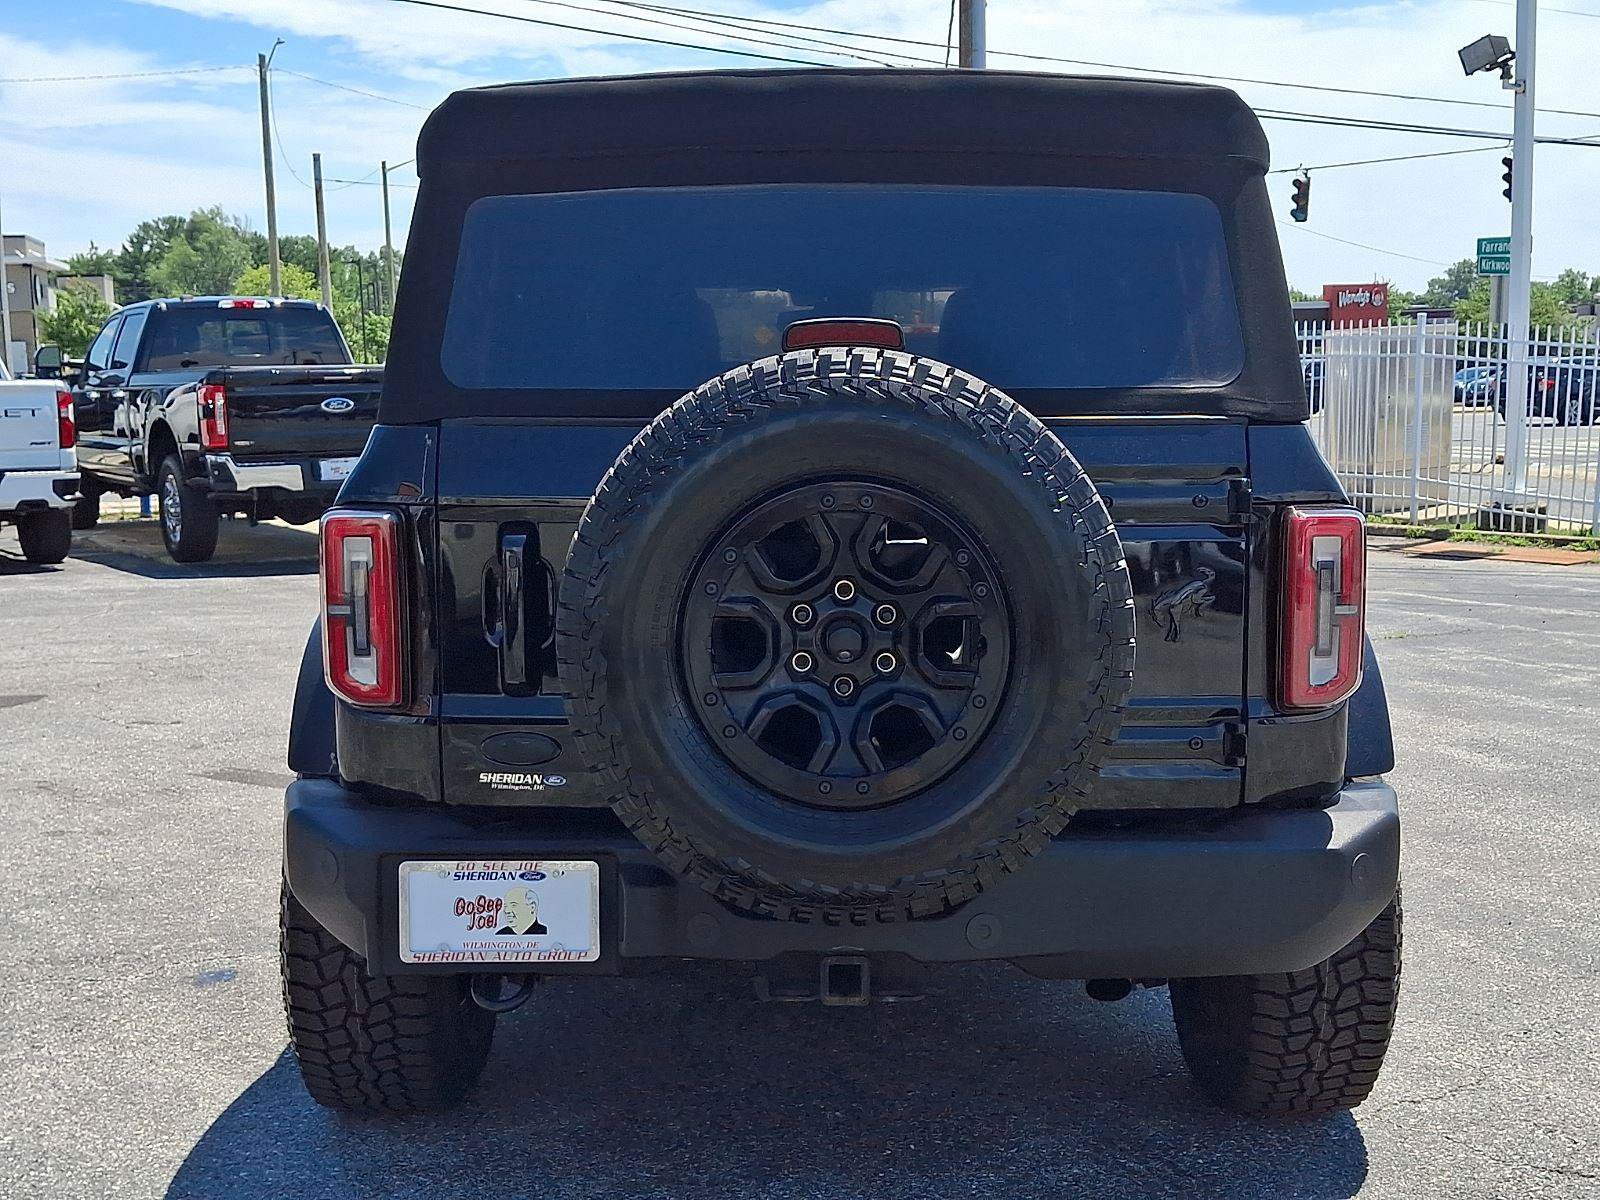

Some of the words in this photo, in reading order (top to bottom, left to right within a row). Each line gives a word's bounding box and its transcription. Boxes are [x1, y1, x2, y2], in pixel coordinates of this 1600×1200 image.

[1338, 288, 1371, 307] Wendy's
[0, 407, 42, 419] ET
[479, 773, 542, 784] SHERIDAN
[456, 862, 475, 871] GO
[482, 862, 506, 871] SEE
[514, 862, 543, 871] JOE
[453, 872, 517, 881] SHERIDAN
[462, 941, 526, 949] WILMINGTON,
[527, 941, 540, 949] DE
[412, 951, 485, 961] SHERIDAN
[492, 951, 532, 961] AUTO
[537, 951, 588, 961] GROUP
